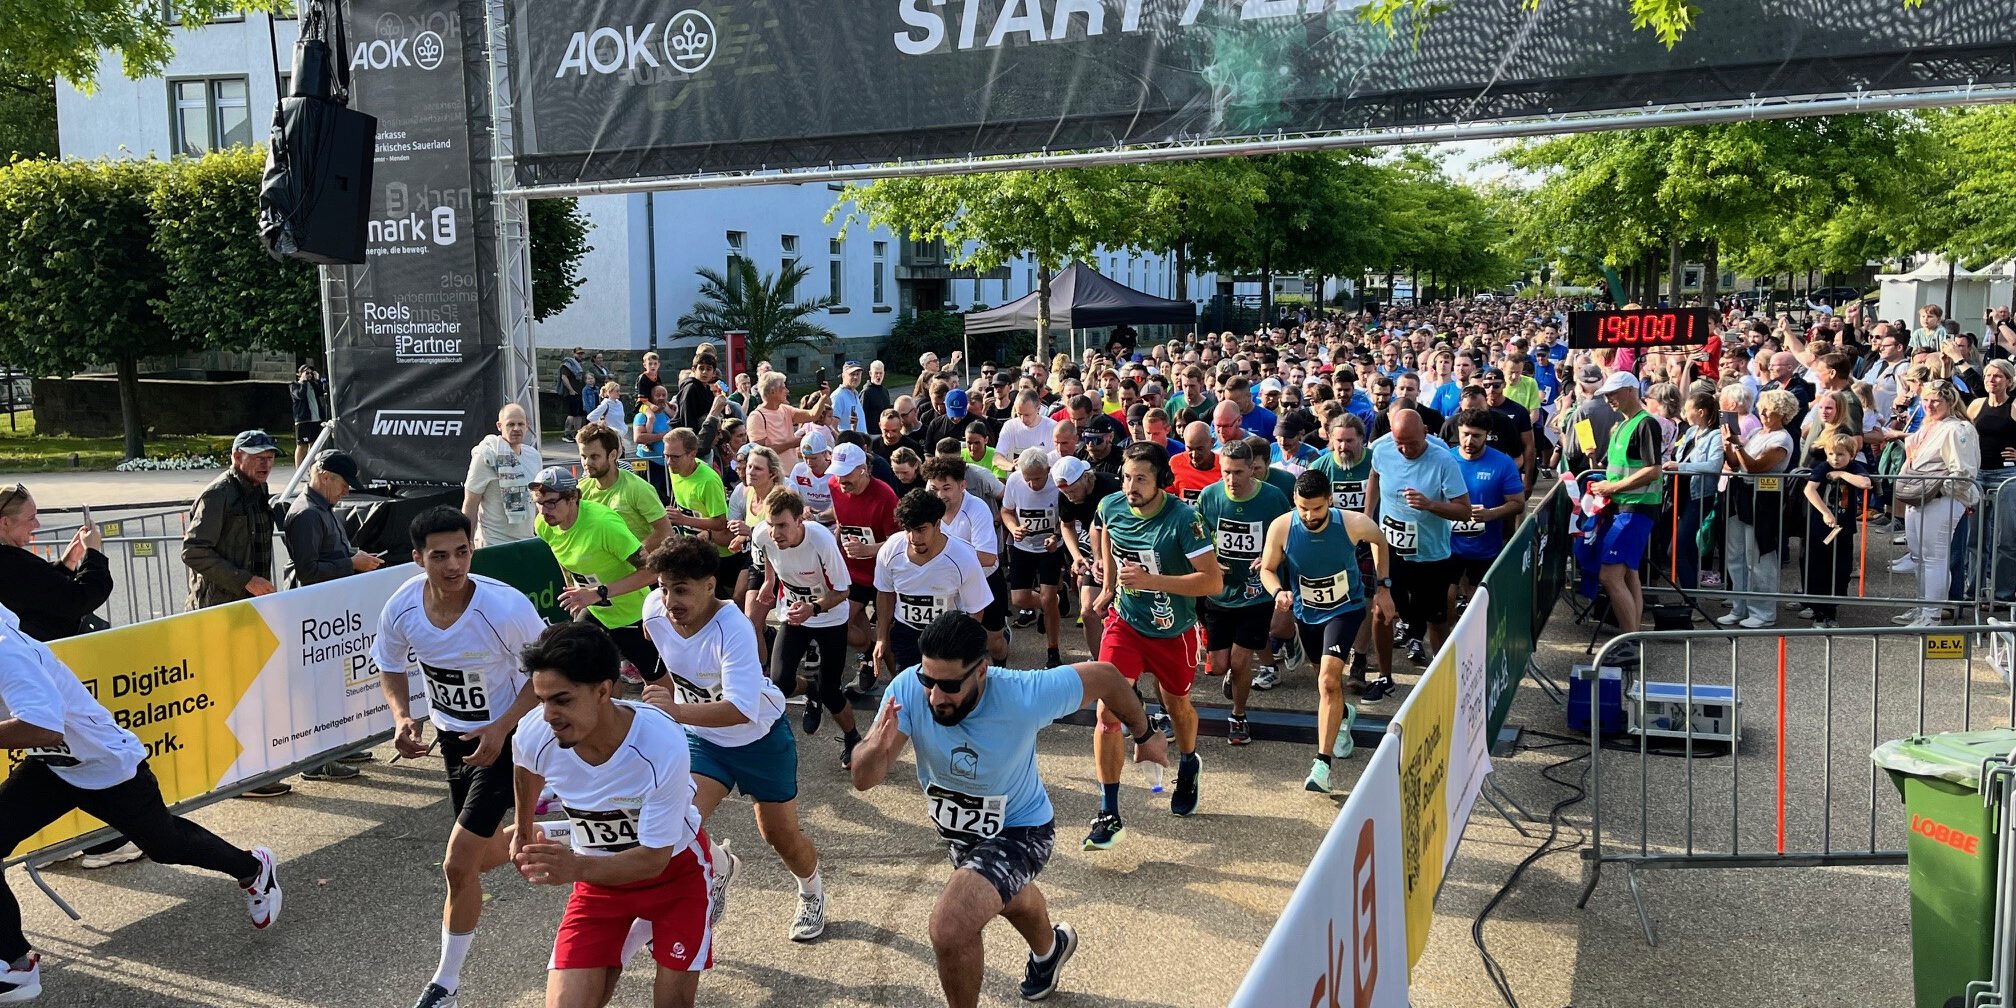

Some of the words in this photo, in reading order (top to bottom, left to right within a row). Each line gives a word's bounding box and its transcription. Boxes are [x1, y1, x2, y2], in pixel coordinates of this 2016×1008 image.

[349, 38, 411, 71] AOK
[555, 22, 660, 78] AOK
[375, 131, 406, 140] arkasse
[375, 143, 411, 153] ärkisches
[412, 139, 451, 151] Sauerland
[366, 248, 389, 256] nergie,
[390, 246, 401, 254] die
[364, 302, 410, 320] Roels
[365, 320, 461, 335] Harnischmacher
[401, 335, 462, 353] Partner
[372, 413, 464, 436] WINNER
[1339, 493, 1366, 507] 347
[1025, 519, 1050, 531] 270
[1223, 533, 1255, 551] 343
[1313, 588, 1335, 602] 31
[302, 609, 362, 645] Roels
[1928, 640, 1962, 649] D.E.V.
[112, 659, 194, 698] Digital.
[428, 680, 486, 709] 1346
[114, 693, 215, 730] Balance.
[272, 736, 290, 747] Dein
[291, 729, 312, 741] neuer
[314, 715, 355, 733] Arbeitgeber
[143, 732, 184, 760] ork.
[576, 820, 640, 843] 134
[1910, 814, 1980, 854] LOBBE
